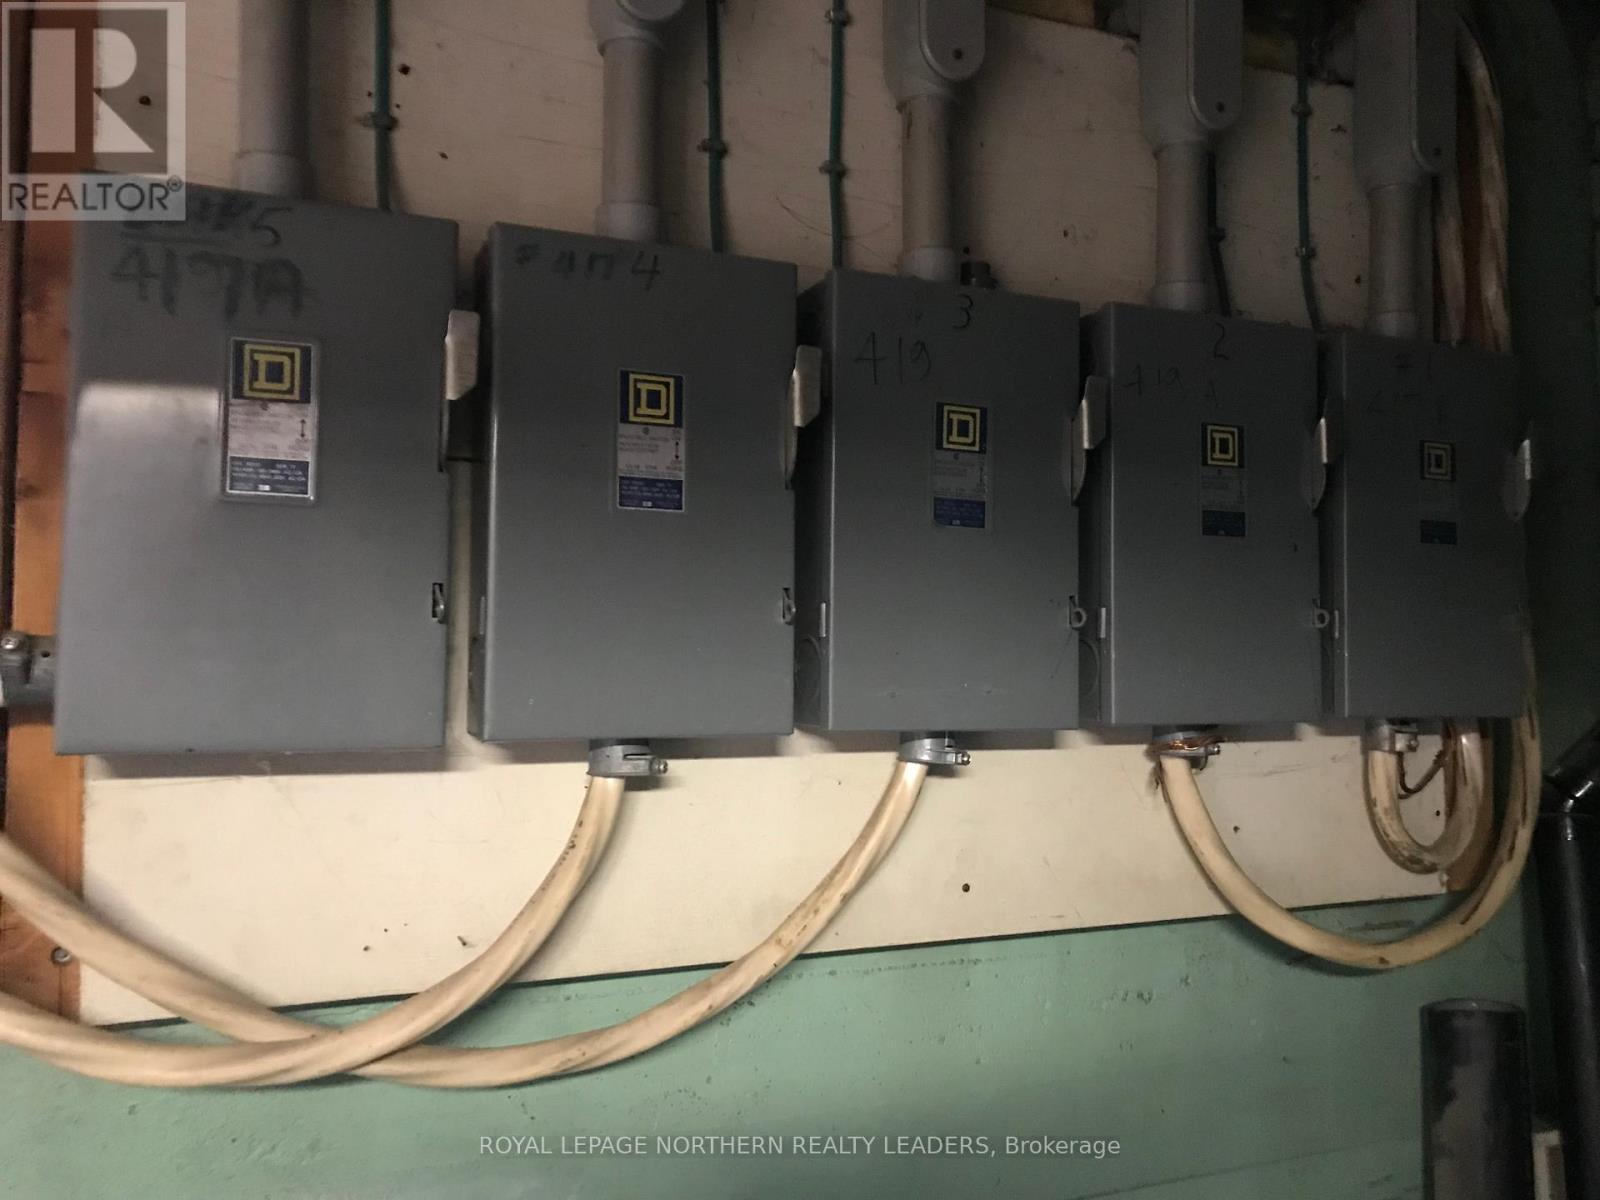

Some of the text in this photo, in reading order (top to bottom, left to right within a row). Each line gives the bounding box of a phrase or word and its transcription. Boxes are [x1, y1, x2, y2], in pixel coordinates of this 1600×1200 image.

[249, 206, 293, 247] 5
[951, 293, 974, 330] 3
[852, 331, 934, 385] 419
[1211, 321, 1230, 361] 2
